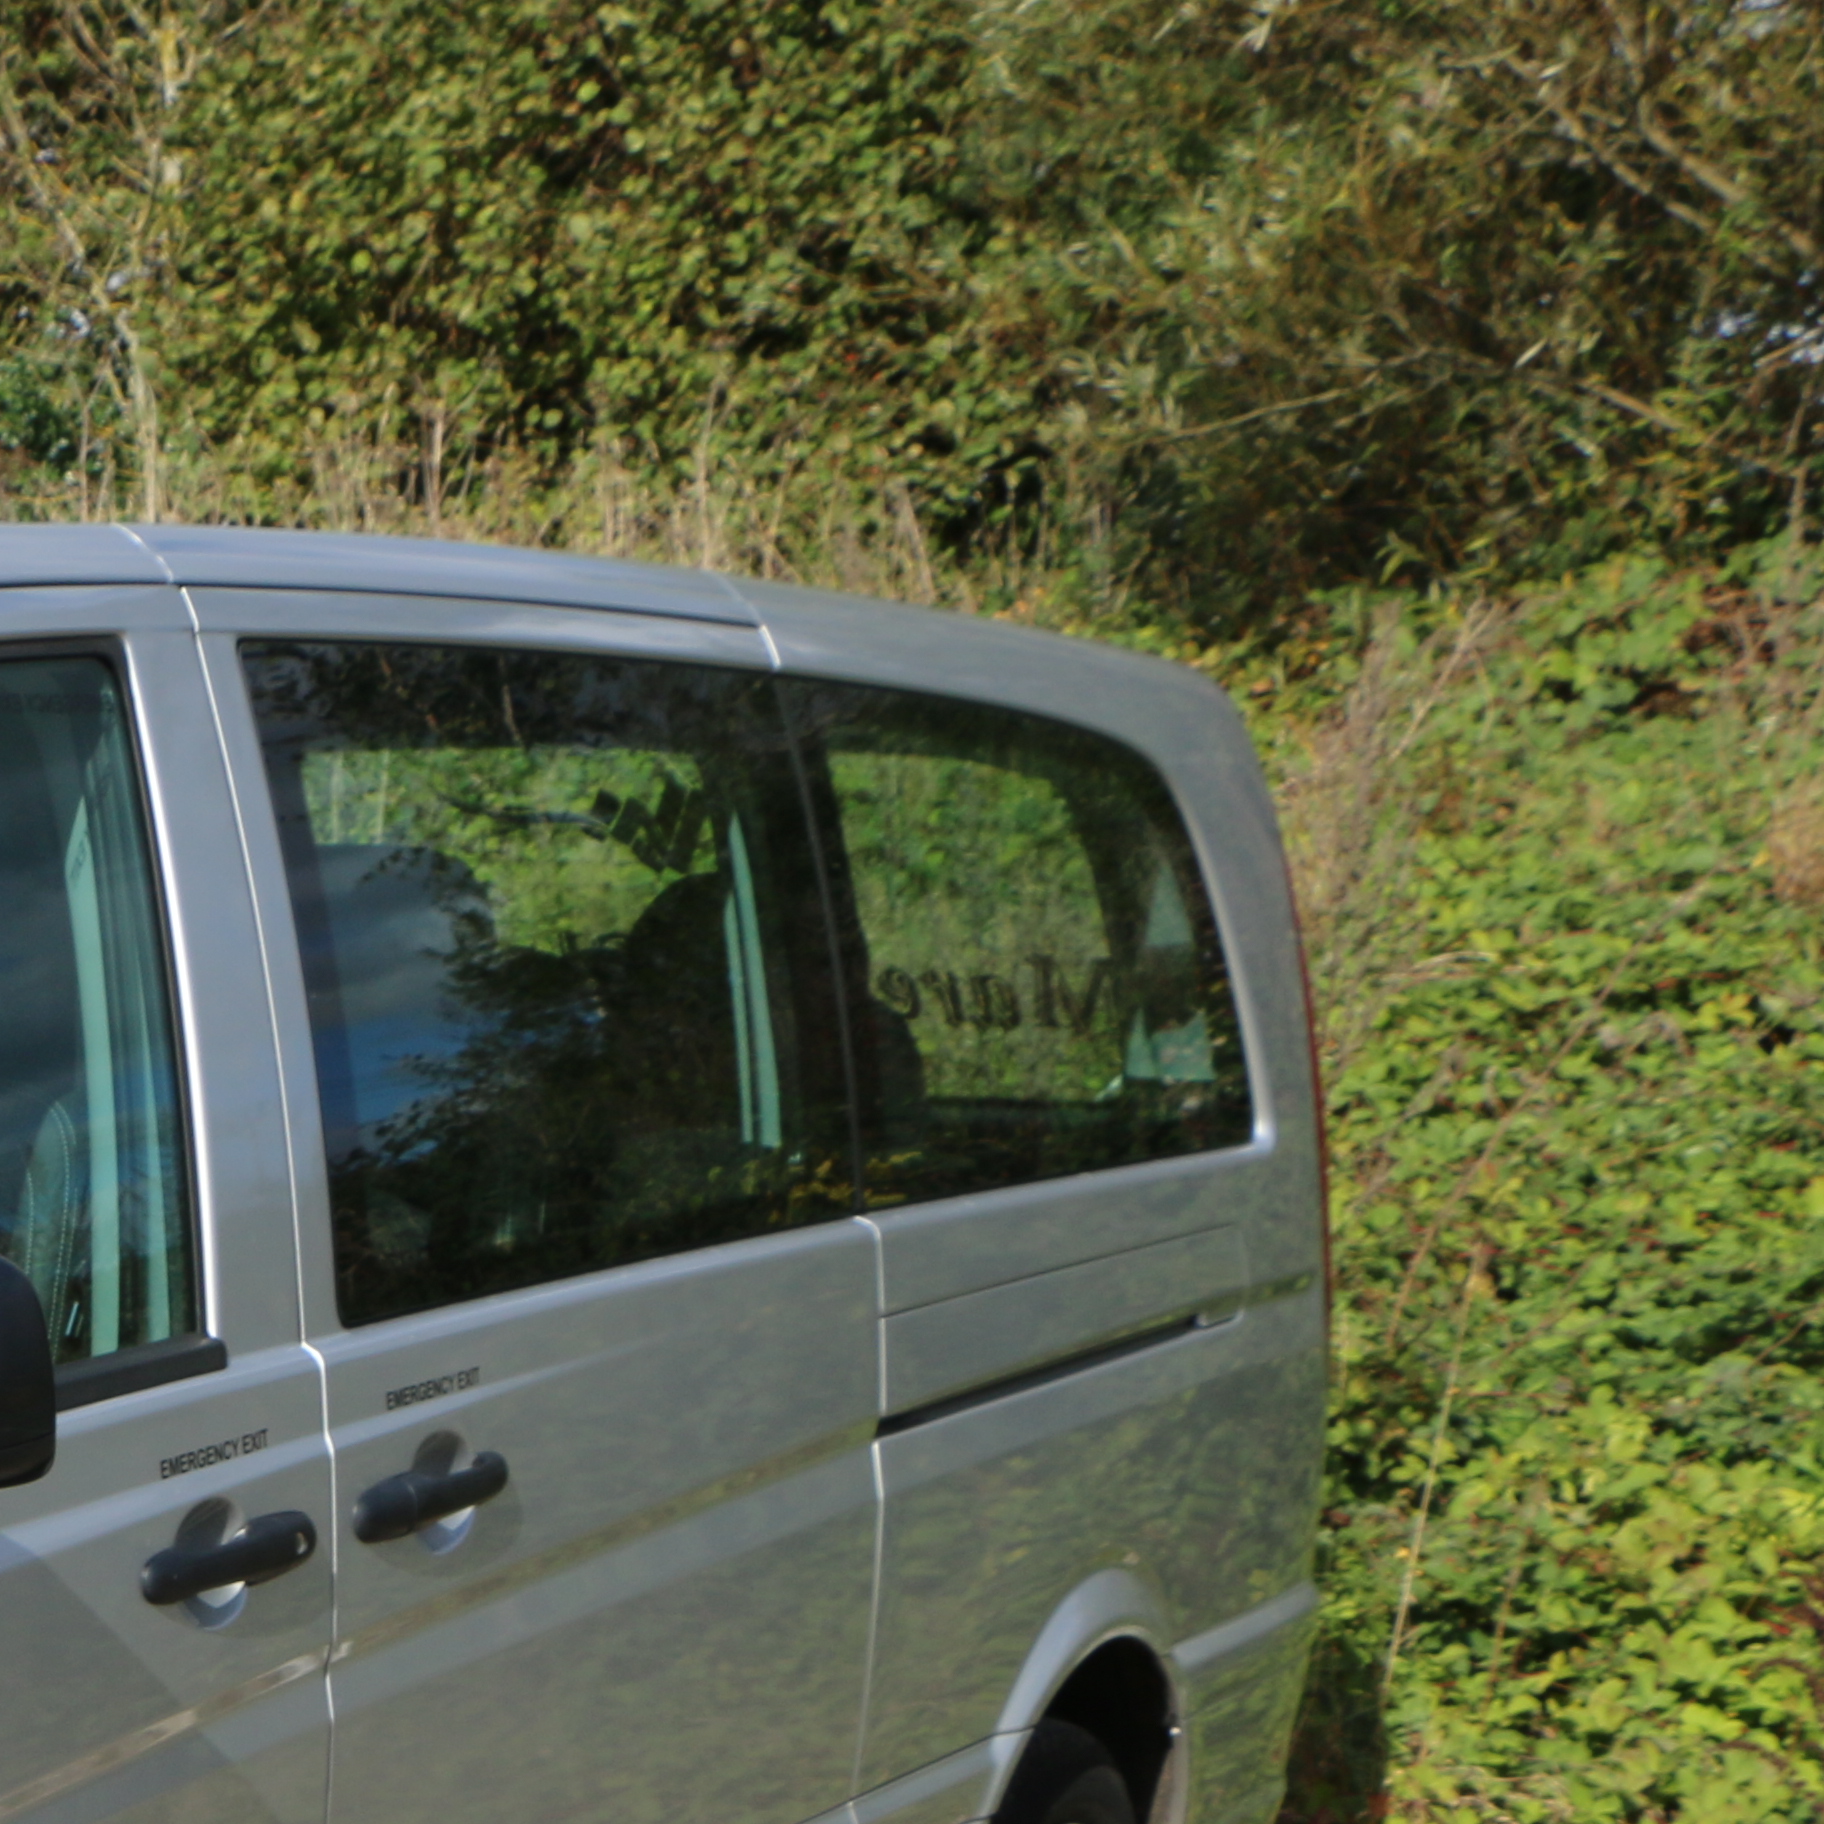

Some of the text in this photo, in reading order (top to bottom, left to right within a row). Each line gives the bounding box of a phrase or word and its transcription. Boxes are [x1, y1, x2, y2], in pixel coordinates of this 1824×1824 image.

[386, 1366, 480, 1411] EMERGENCY EXIT
[160, 1428, 269, 1479] EMERGENCY EXIT
